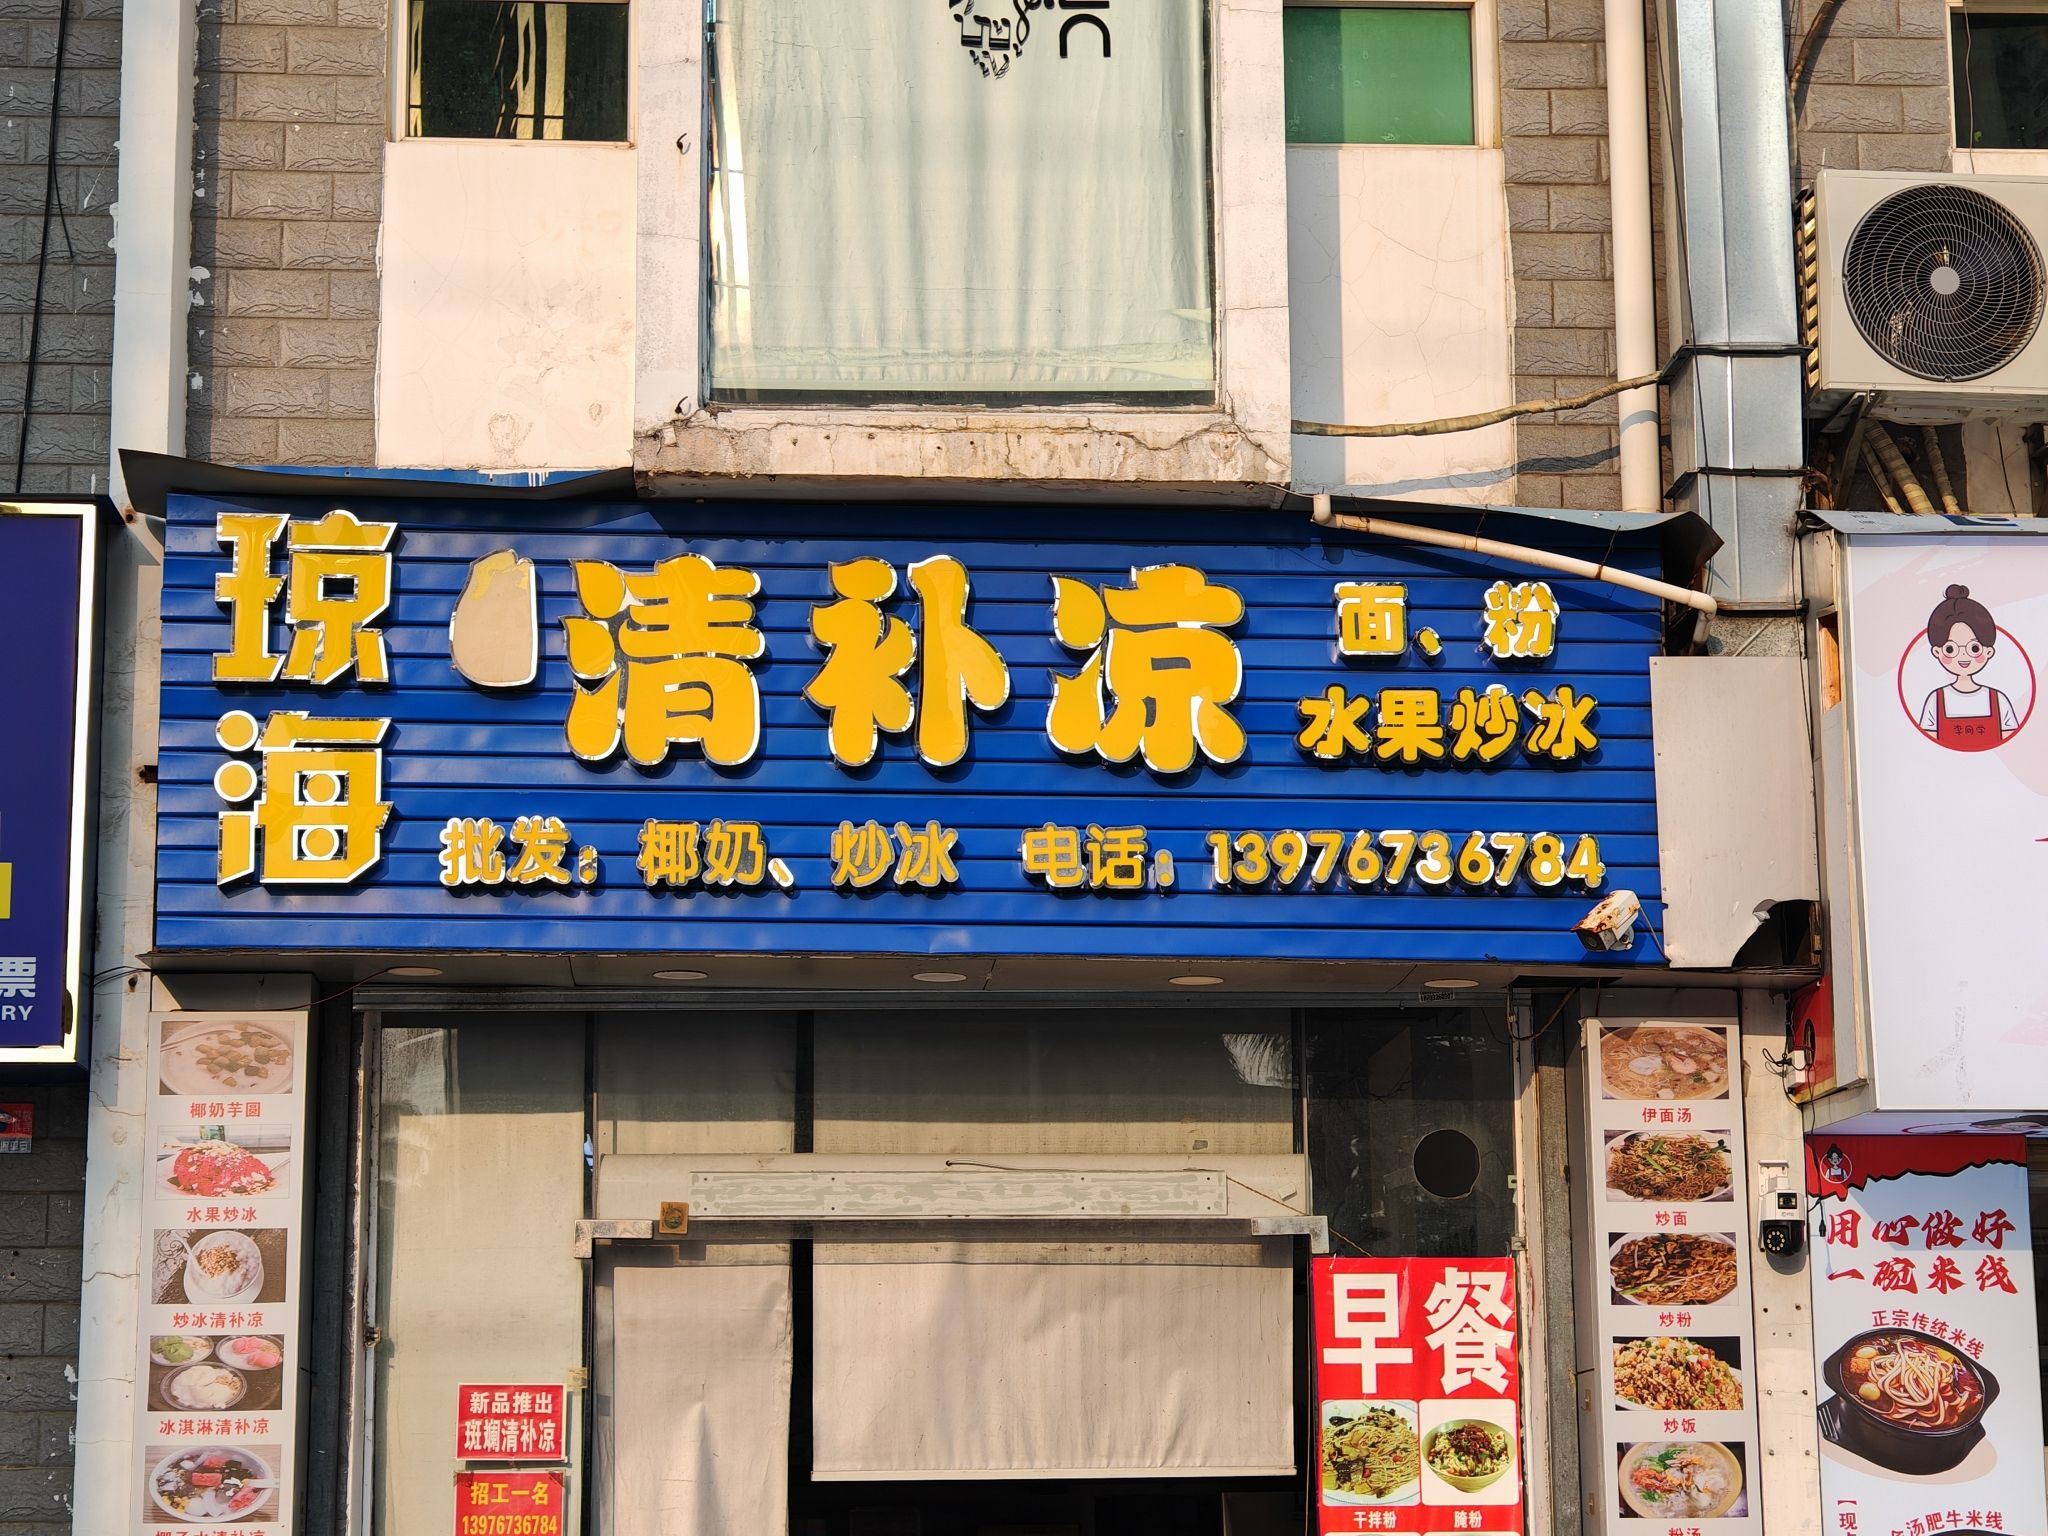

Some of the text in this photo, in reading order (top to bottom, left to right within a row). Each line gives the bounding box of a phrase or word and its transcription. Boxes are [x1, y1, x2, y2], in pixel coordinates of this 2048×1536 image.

[561, 551, 1246, 774] 清补凉
[1297, 684, 1600, 763] 水果炒冰
[190, 1102, 261, 1118] 椰奶芋圆
[1642, 1107, 1692, 1123] 伊面汤
[186, 1206, 257, 1222] 水果炒冰
[1655, 1211, 1688, 1226] 炒面
[1827, 1209, 2016, 1250] 用心做好
[1827, 1255, 2018, 1295] 一碗米线
[173, 1311, 265, 1329] 炒冰清补凉
[1659, 1311, 1692, 1327] 炒粉
[1323, 1267, 1515, 1395] 早餐
[1871, 1309, 1985, 1360] 正宗传统米线
[470, 1392, 553, 1414] 新品推出
[159, 1418, 270, 1435] 冰淇淋清补凉
[1664, 1418, 1697, 1434] 炒饭
[470, 1482, 549, 1505] 招工一名
[462, 1515, 558, 1535] 13976736784
[1353, 1511, 1397, 1529] 干拌粉
